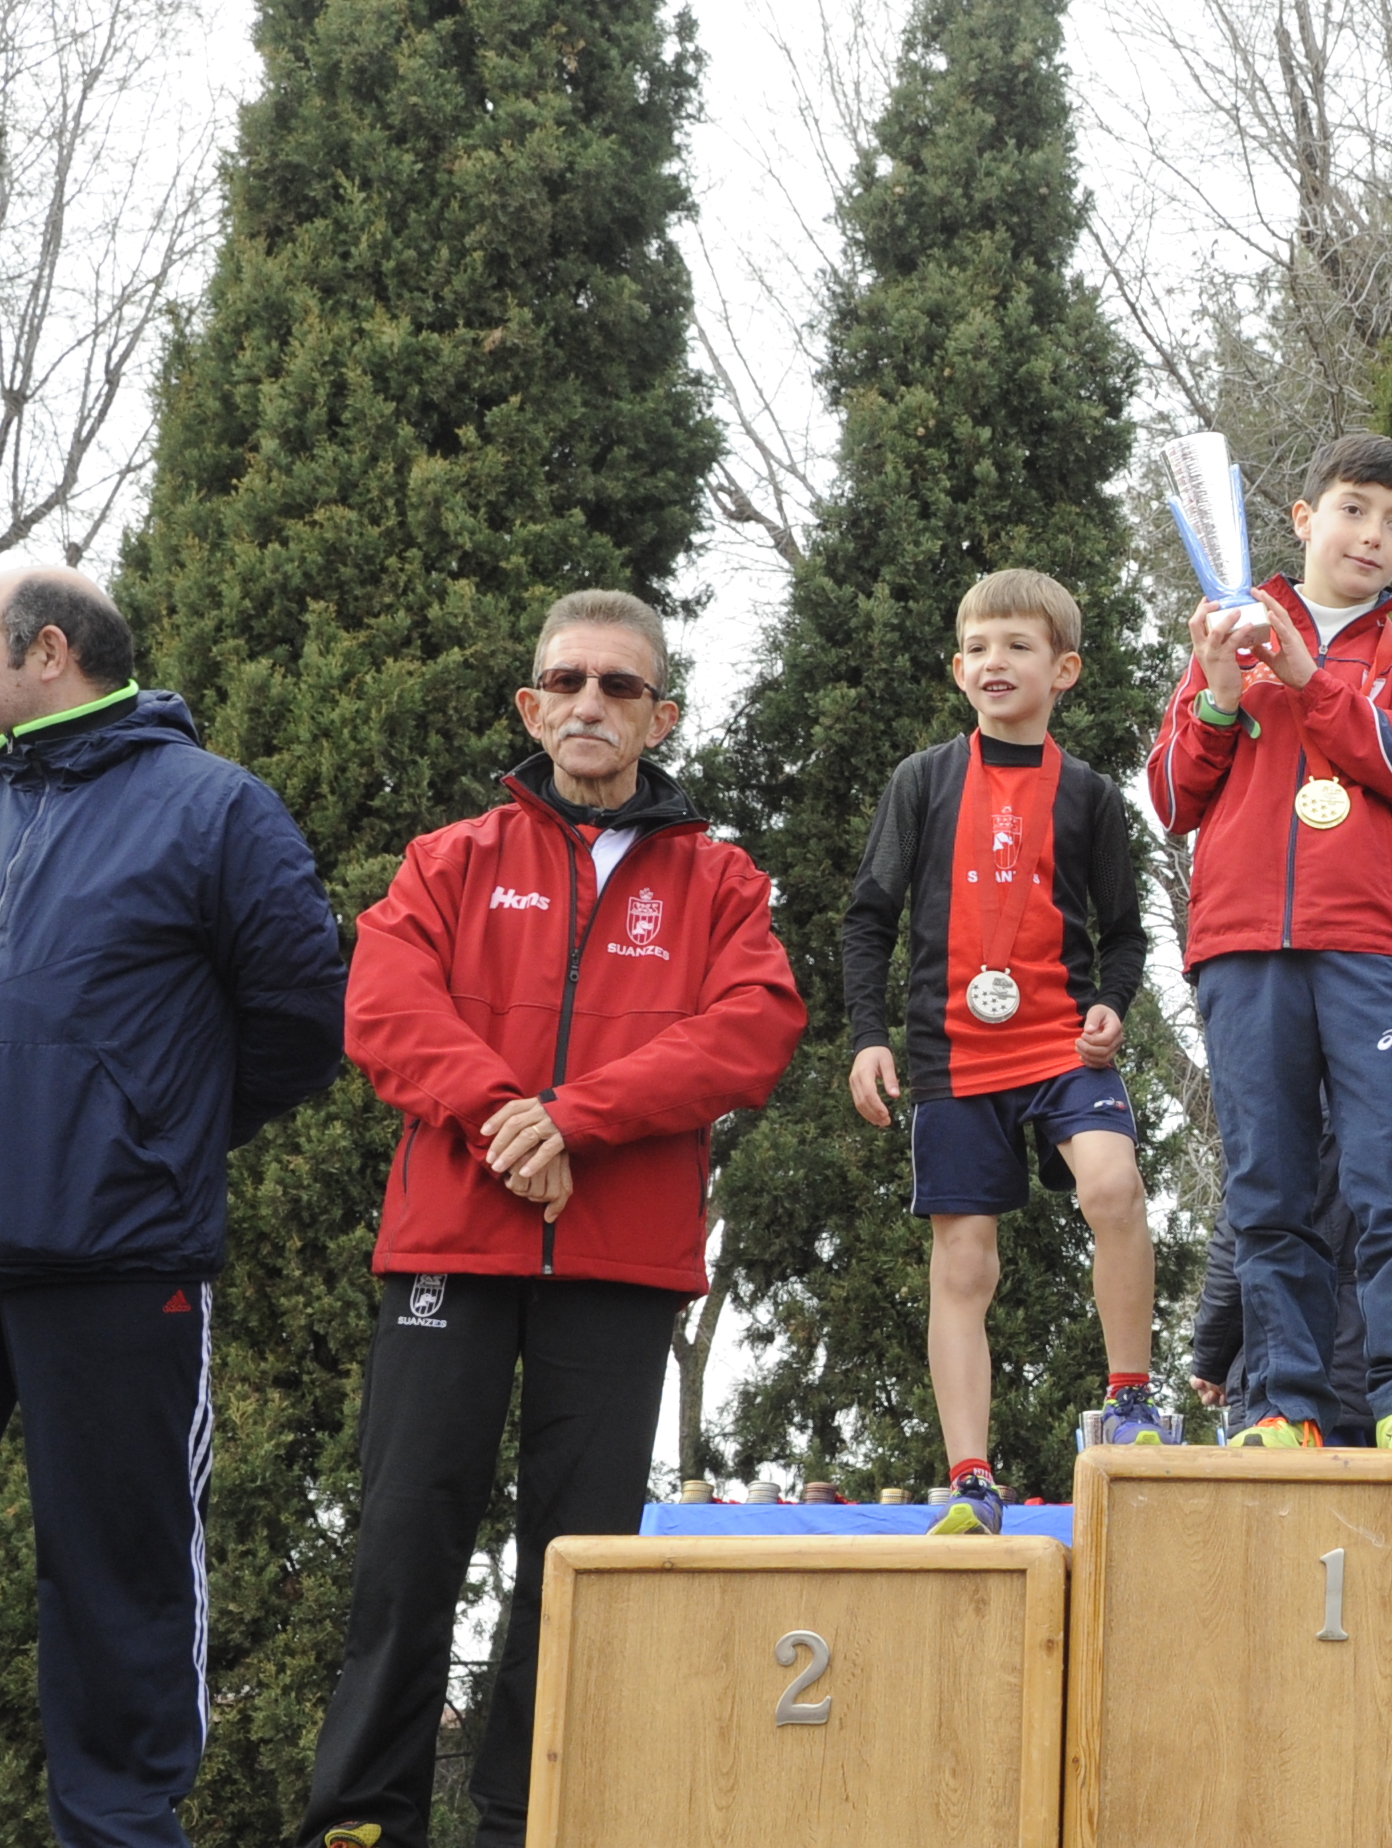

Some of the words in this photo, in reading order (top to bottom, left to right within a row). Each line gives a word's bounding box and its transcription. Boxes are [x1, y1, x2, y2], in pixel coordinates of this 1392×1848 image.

[607, 942, 670, 961] SUANZES
[397, 1316, 447, 1328] SUANZES
[1315, 1547, 1350, 1641] 1
[774, 1629, 833, 1728] 2
